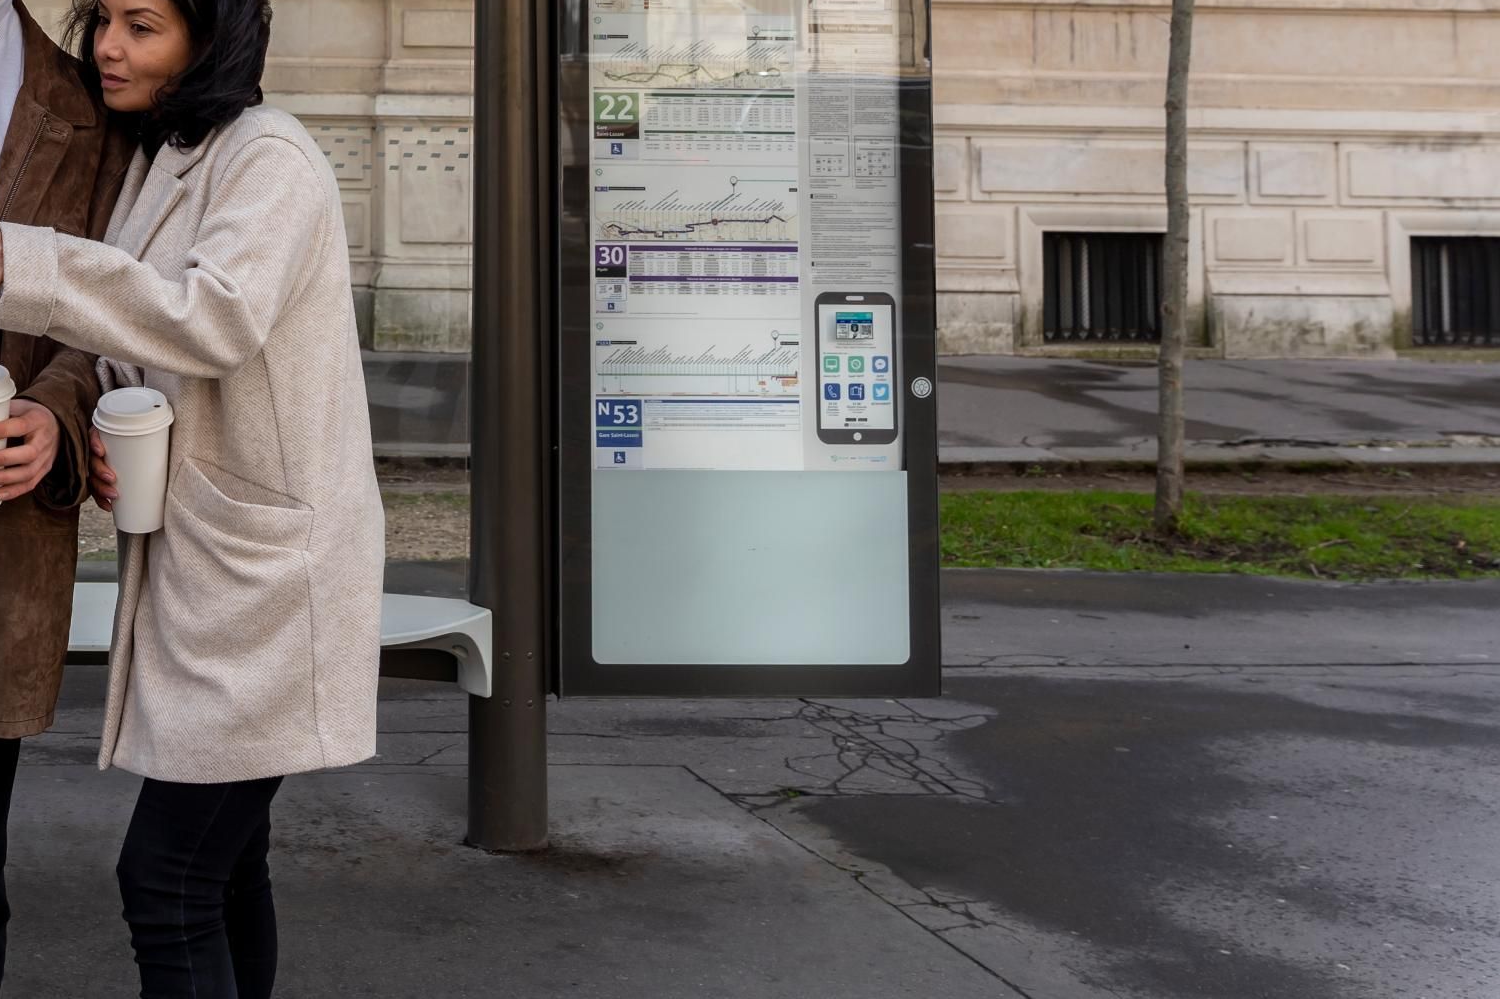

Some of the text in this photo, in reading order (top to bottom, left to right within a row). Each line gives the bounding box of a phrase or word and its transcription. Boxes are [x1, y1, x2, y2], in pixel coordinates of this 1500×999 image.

[598, 94, 634, 120] 22
[598, 246, 624, 265] 30
[598, 402, 610, 416] N
[613, 404, 638, 424] 53
